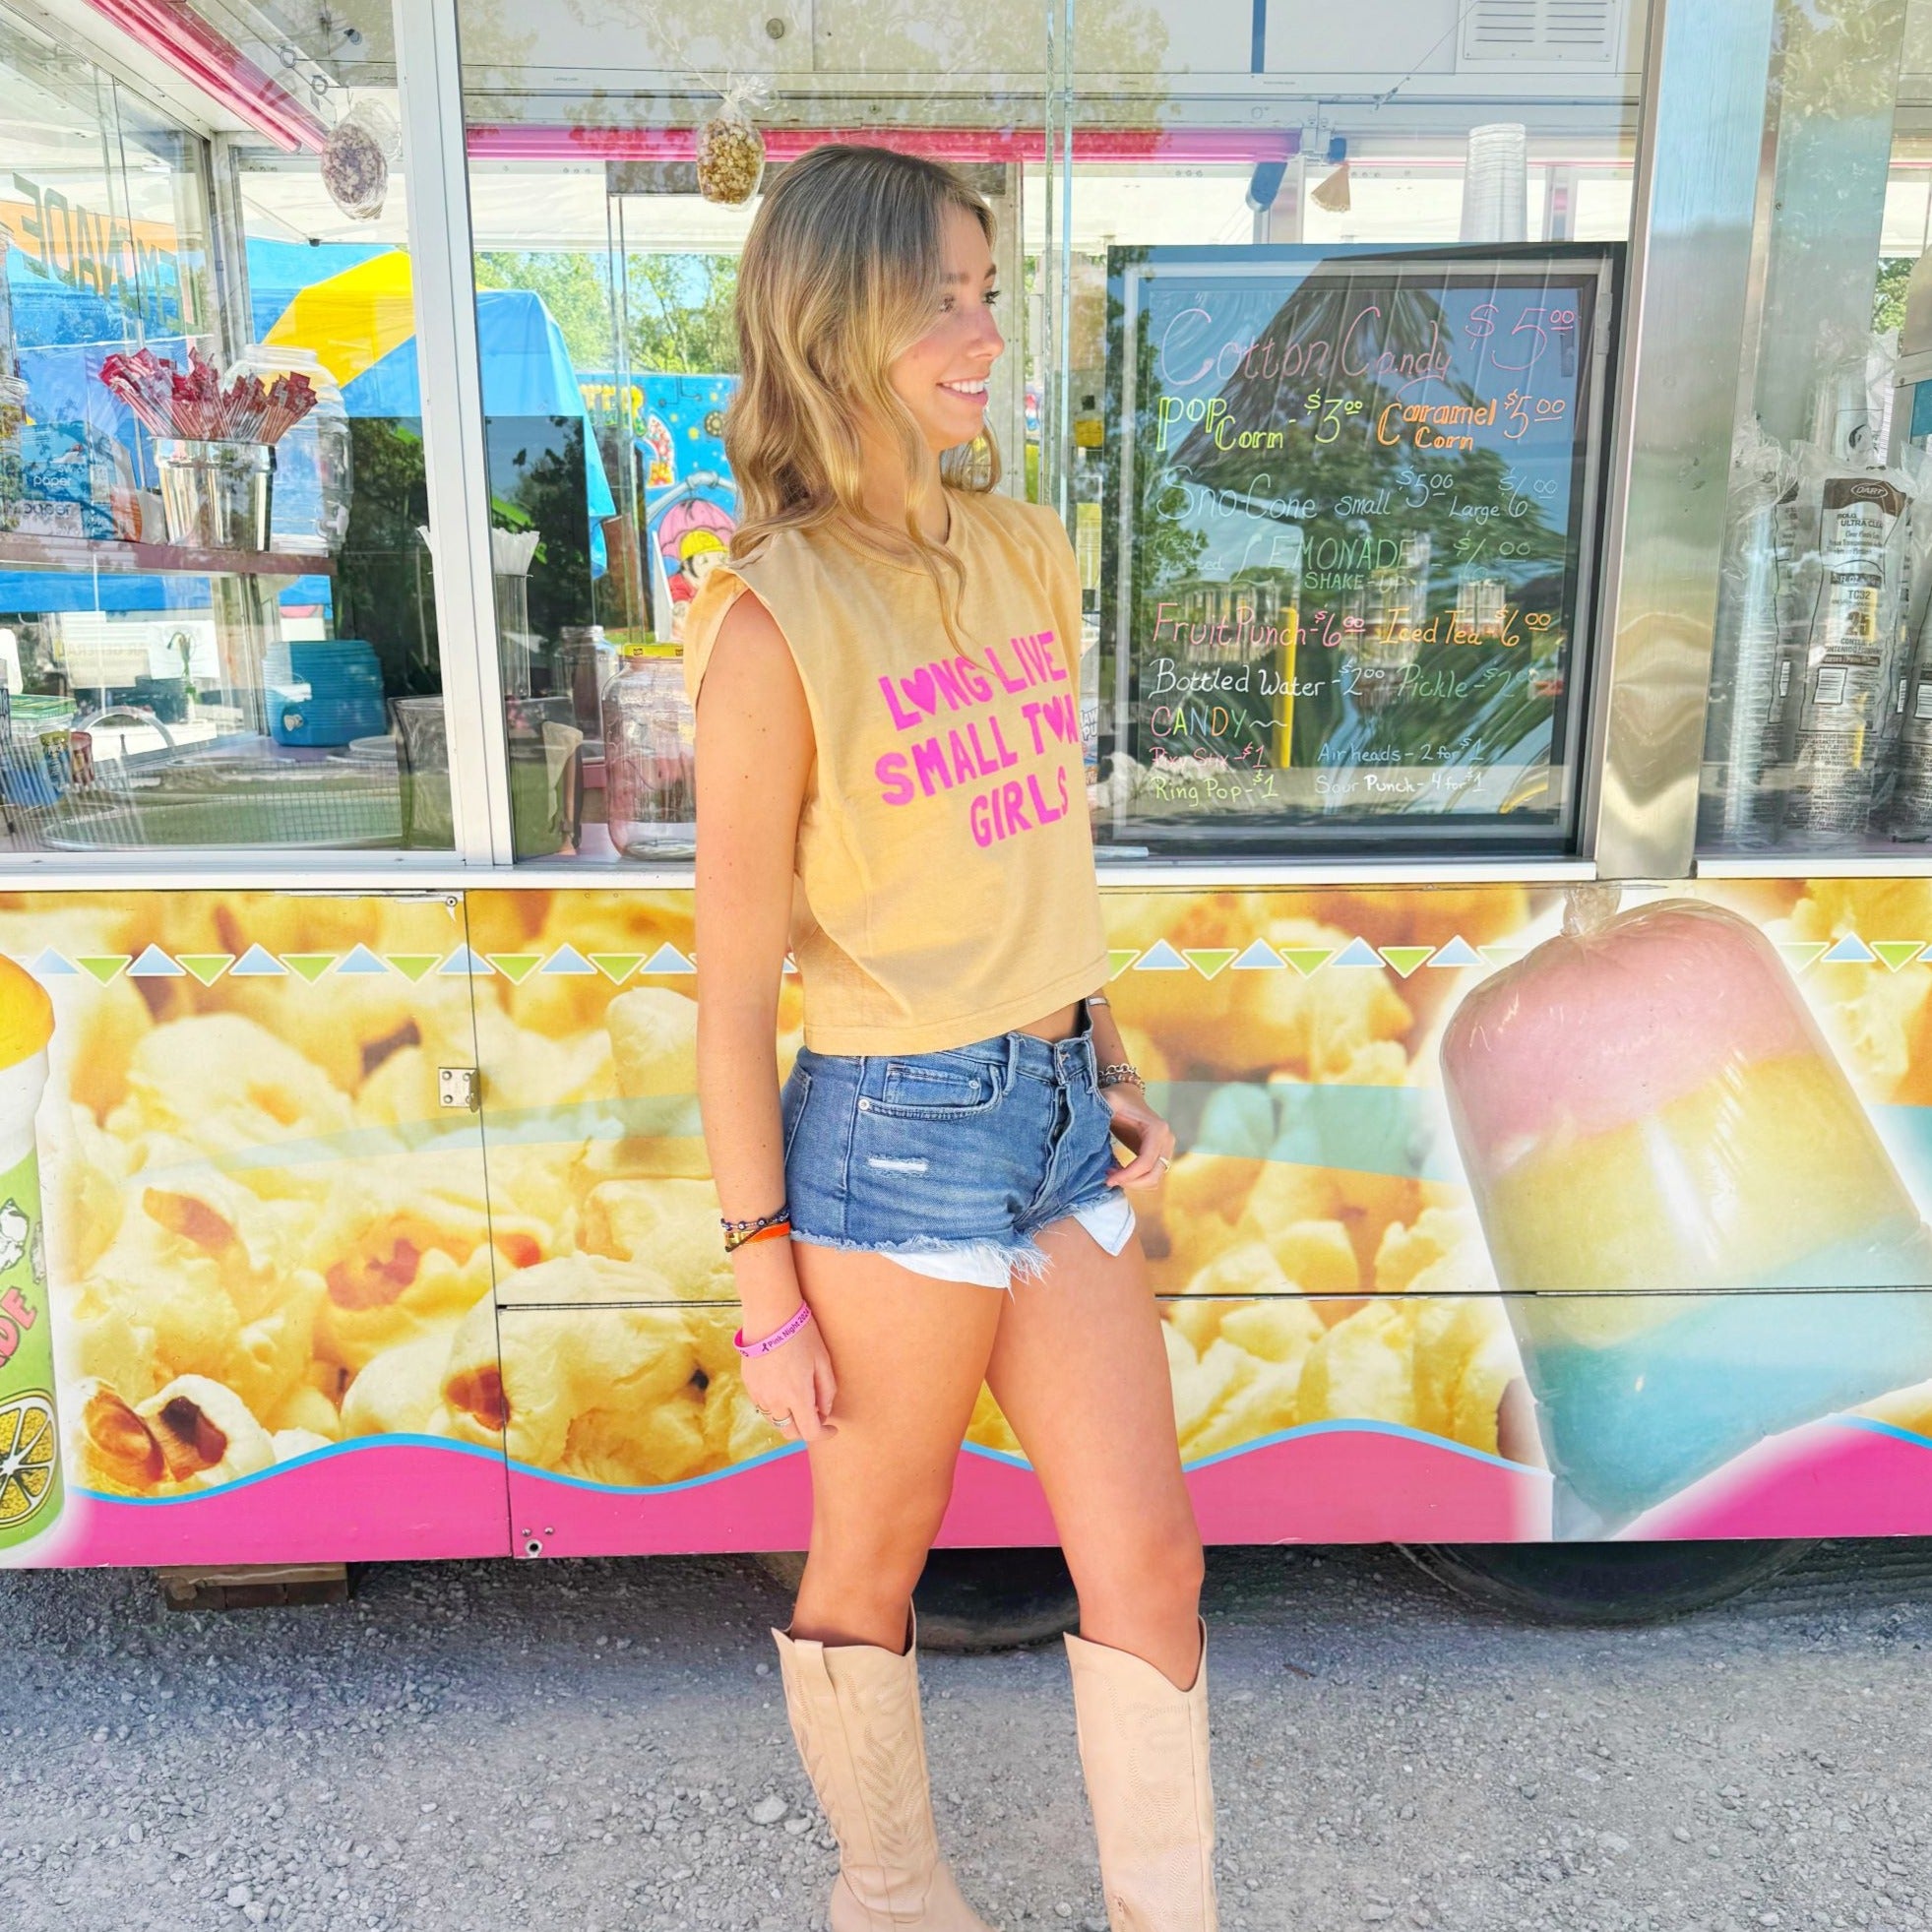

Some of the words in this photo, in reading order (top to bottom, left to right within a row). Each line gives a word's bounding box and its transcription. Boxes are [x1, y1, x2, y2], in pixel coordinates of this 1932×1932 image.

[1160, 308, 1330, 386] Cotton
[1340, 306, 1452, 403] Candy
[1215, 415, 1283, 451] Corn
[1378, 398, 1497, 446] Caramel
[1414, 425, 1473, 452] Corn
[33, 475, 72, 488] paper
[1156, 465, 1237, 520] Sno
[1245, 472, 1318, 520] Cone
[1448, 495, 1501, 526] Large
[1229, 531, 1416, 588] LEMONADE
[1848, 590, 1871, 600] TC32
[1153, 602, 1227, 647] Fruit
[1378, 606, 1439, 646] Iced
[1845, 610, 1871, 637] 25
[878, 655, 994, 731] LNG
[984, 630, 1068, 695] LIVE
[1149, 657, 1250, 699] Bottled
[1258, 668, 1326, 697] Water
[1396, 663, 1468, 698] Pickle
[1150, 705, 1248, 738] CANDY
[874, 715, 1019, 806] SMALL
[1419, 743, 1434, 761] 2
[1436, 745, 1461, 760] for
[970, 765, 1069, 848] GIRLS
[1150, 776, 1199, 808] Ring
[1315, 775, 1359, 794] Sour
[1363, 774, 1416, 793] Punch
[1431, 772, 1442, 791] 4
[767, 1335, 784, 1348] Pink
[781, 1321, 801, 1338] Night
